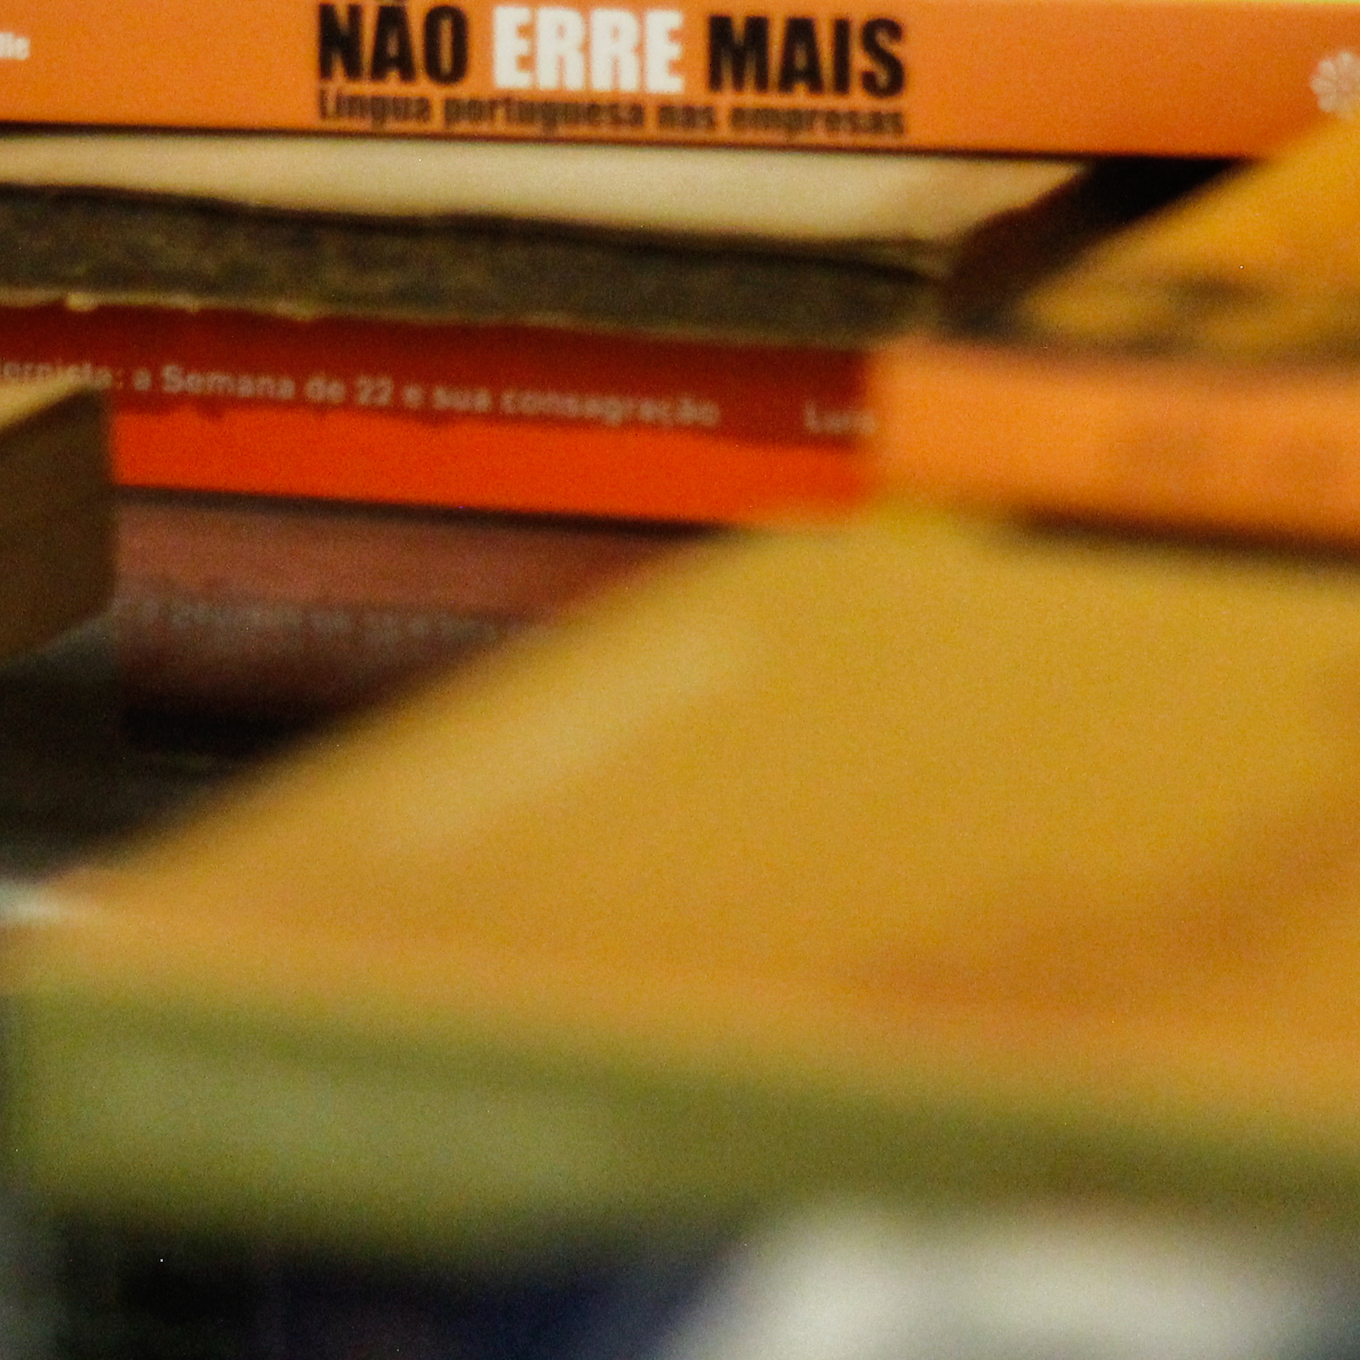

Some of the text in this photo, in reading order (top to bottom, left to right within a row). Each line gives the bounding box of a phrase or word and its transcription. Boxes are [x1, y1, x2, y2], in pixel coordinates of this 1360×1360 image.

[491, 4, 685, 96] ERRE
[706, 14, 907, 99] MAIS
[444, 95, 644, 137] portuguesa
[656, 104, 716, 130] nas
[729, 106, 906, 139] empresas
[160, 364, 295, 400] Semana
[304, 373, 346, 404] de
[353, 375, 392, 406] 22
[403, 384, 423, 408] e
[433, 387, 491, 413] sua
